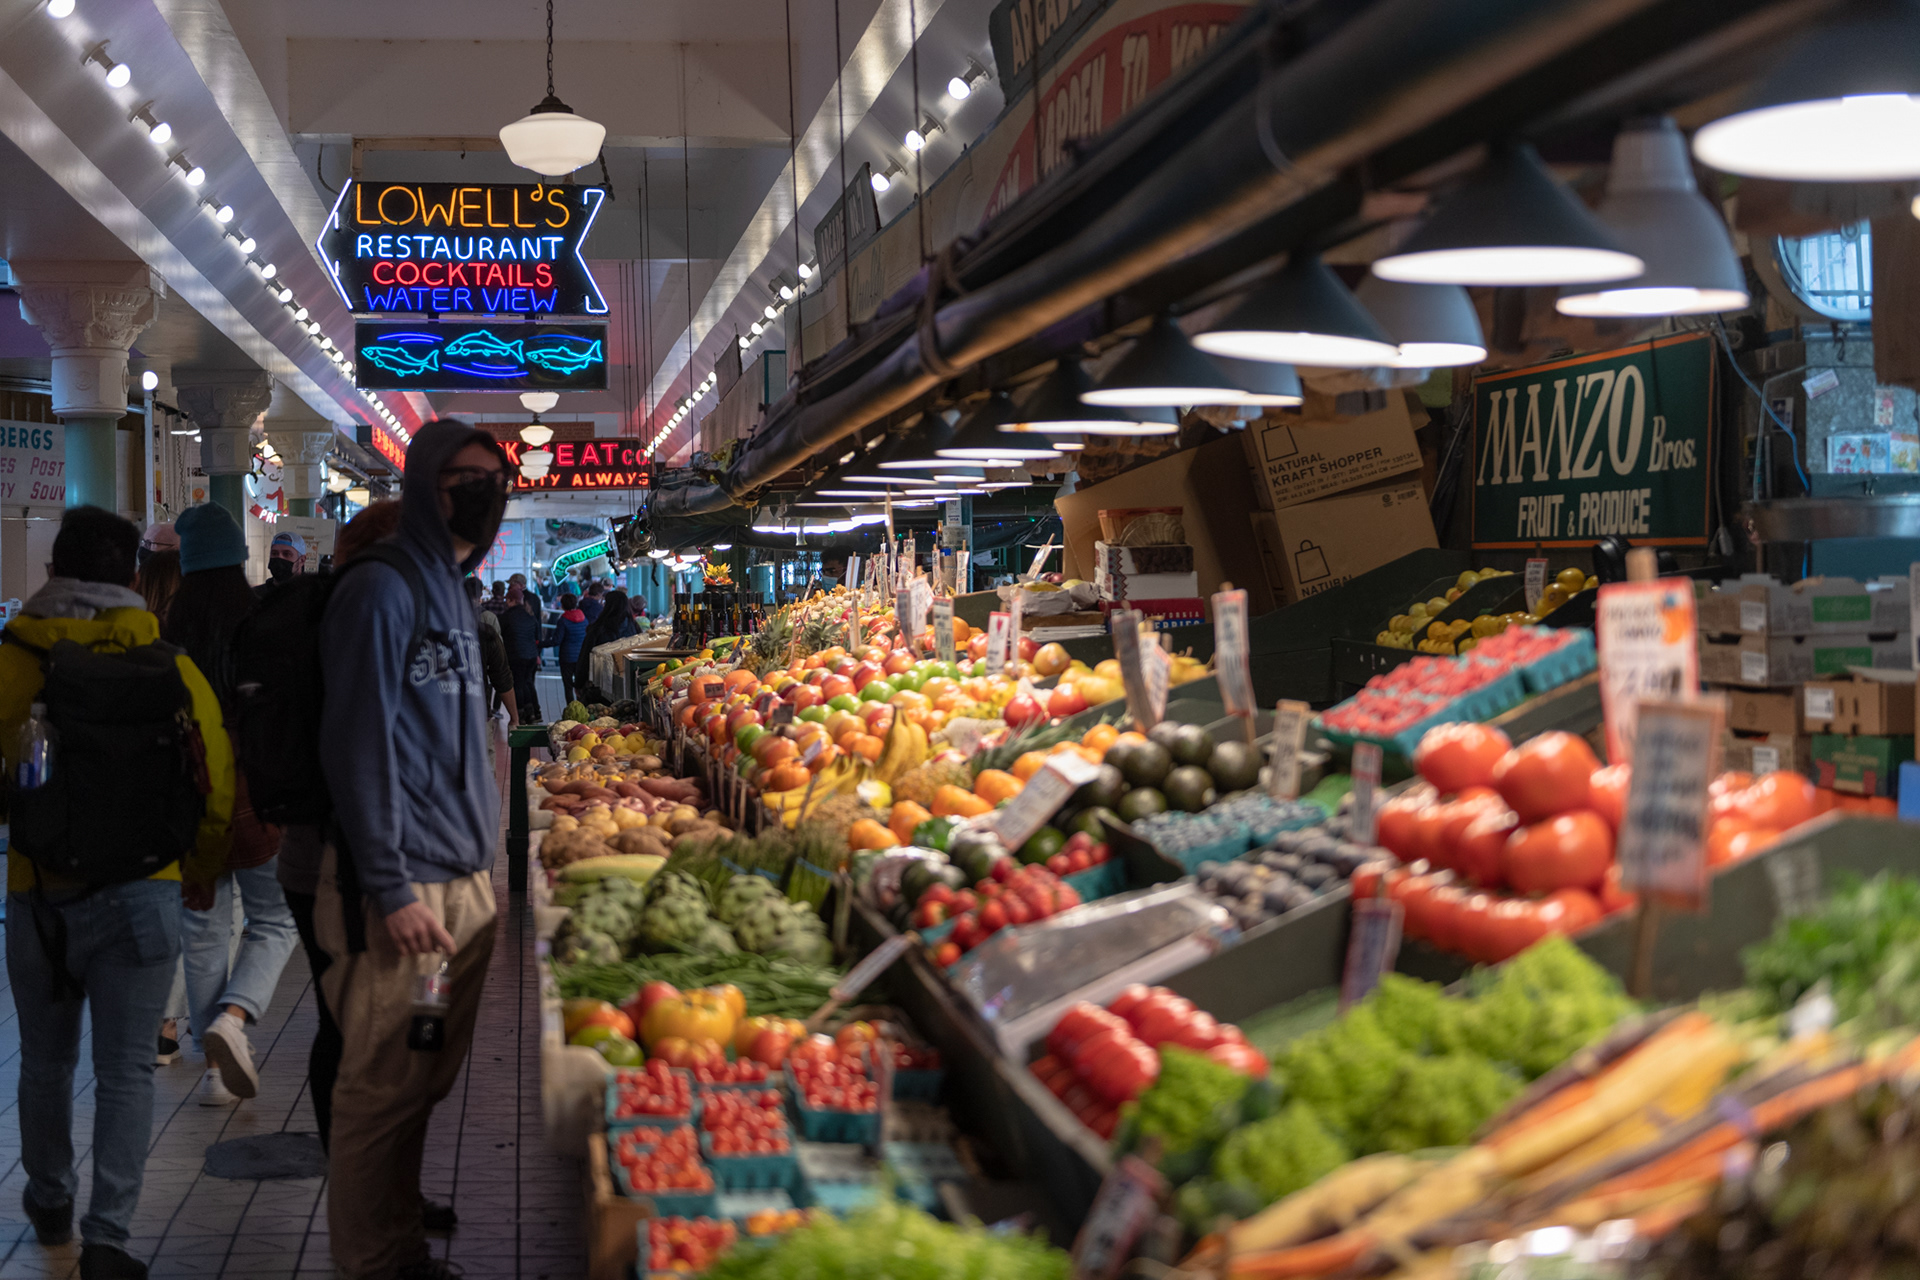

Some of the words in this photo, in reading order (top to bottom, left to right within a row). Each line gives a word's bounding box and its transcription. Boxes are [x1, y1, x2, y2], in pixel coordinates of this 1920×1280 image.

[1121, 33, 1149, 115] TO
[357, 183, 570, 228] LOWELL'S
[357, 235, 564, 260] RESTAURANT
[373, 262, 553, 286] COCKTAILS
[364, 287, 473, 311] WATER
[482, 288, 558, 312] VIEW
[1477, 365, 1645, 486] MANZO
[1647, 415, 1697, 472] Bros.
[528, 442, 620, 466] EAT
[1268, 452, 1326, 476] NATURAL
[1272, 466, 1316, 488] KRAFT
[1319, 447, 1383, 474] SHOPPER
[513, 474, 561, 488] LITY
[572, 472, 649, 487] ALWAYS
[1517, 494, 1565, 538] FRUIT
[1567, 510, 1576, 537] &
[1578, 488, 1651, 537] PRODUCE
[554, 541, 609, 576] RESTROOMS
